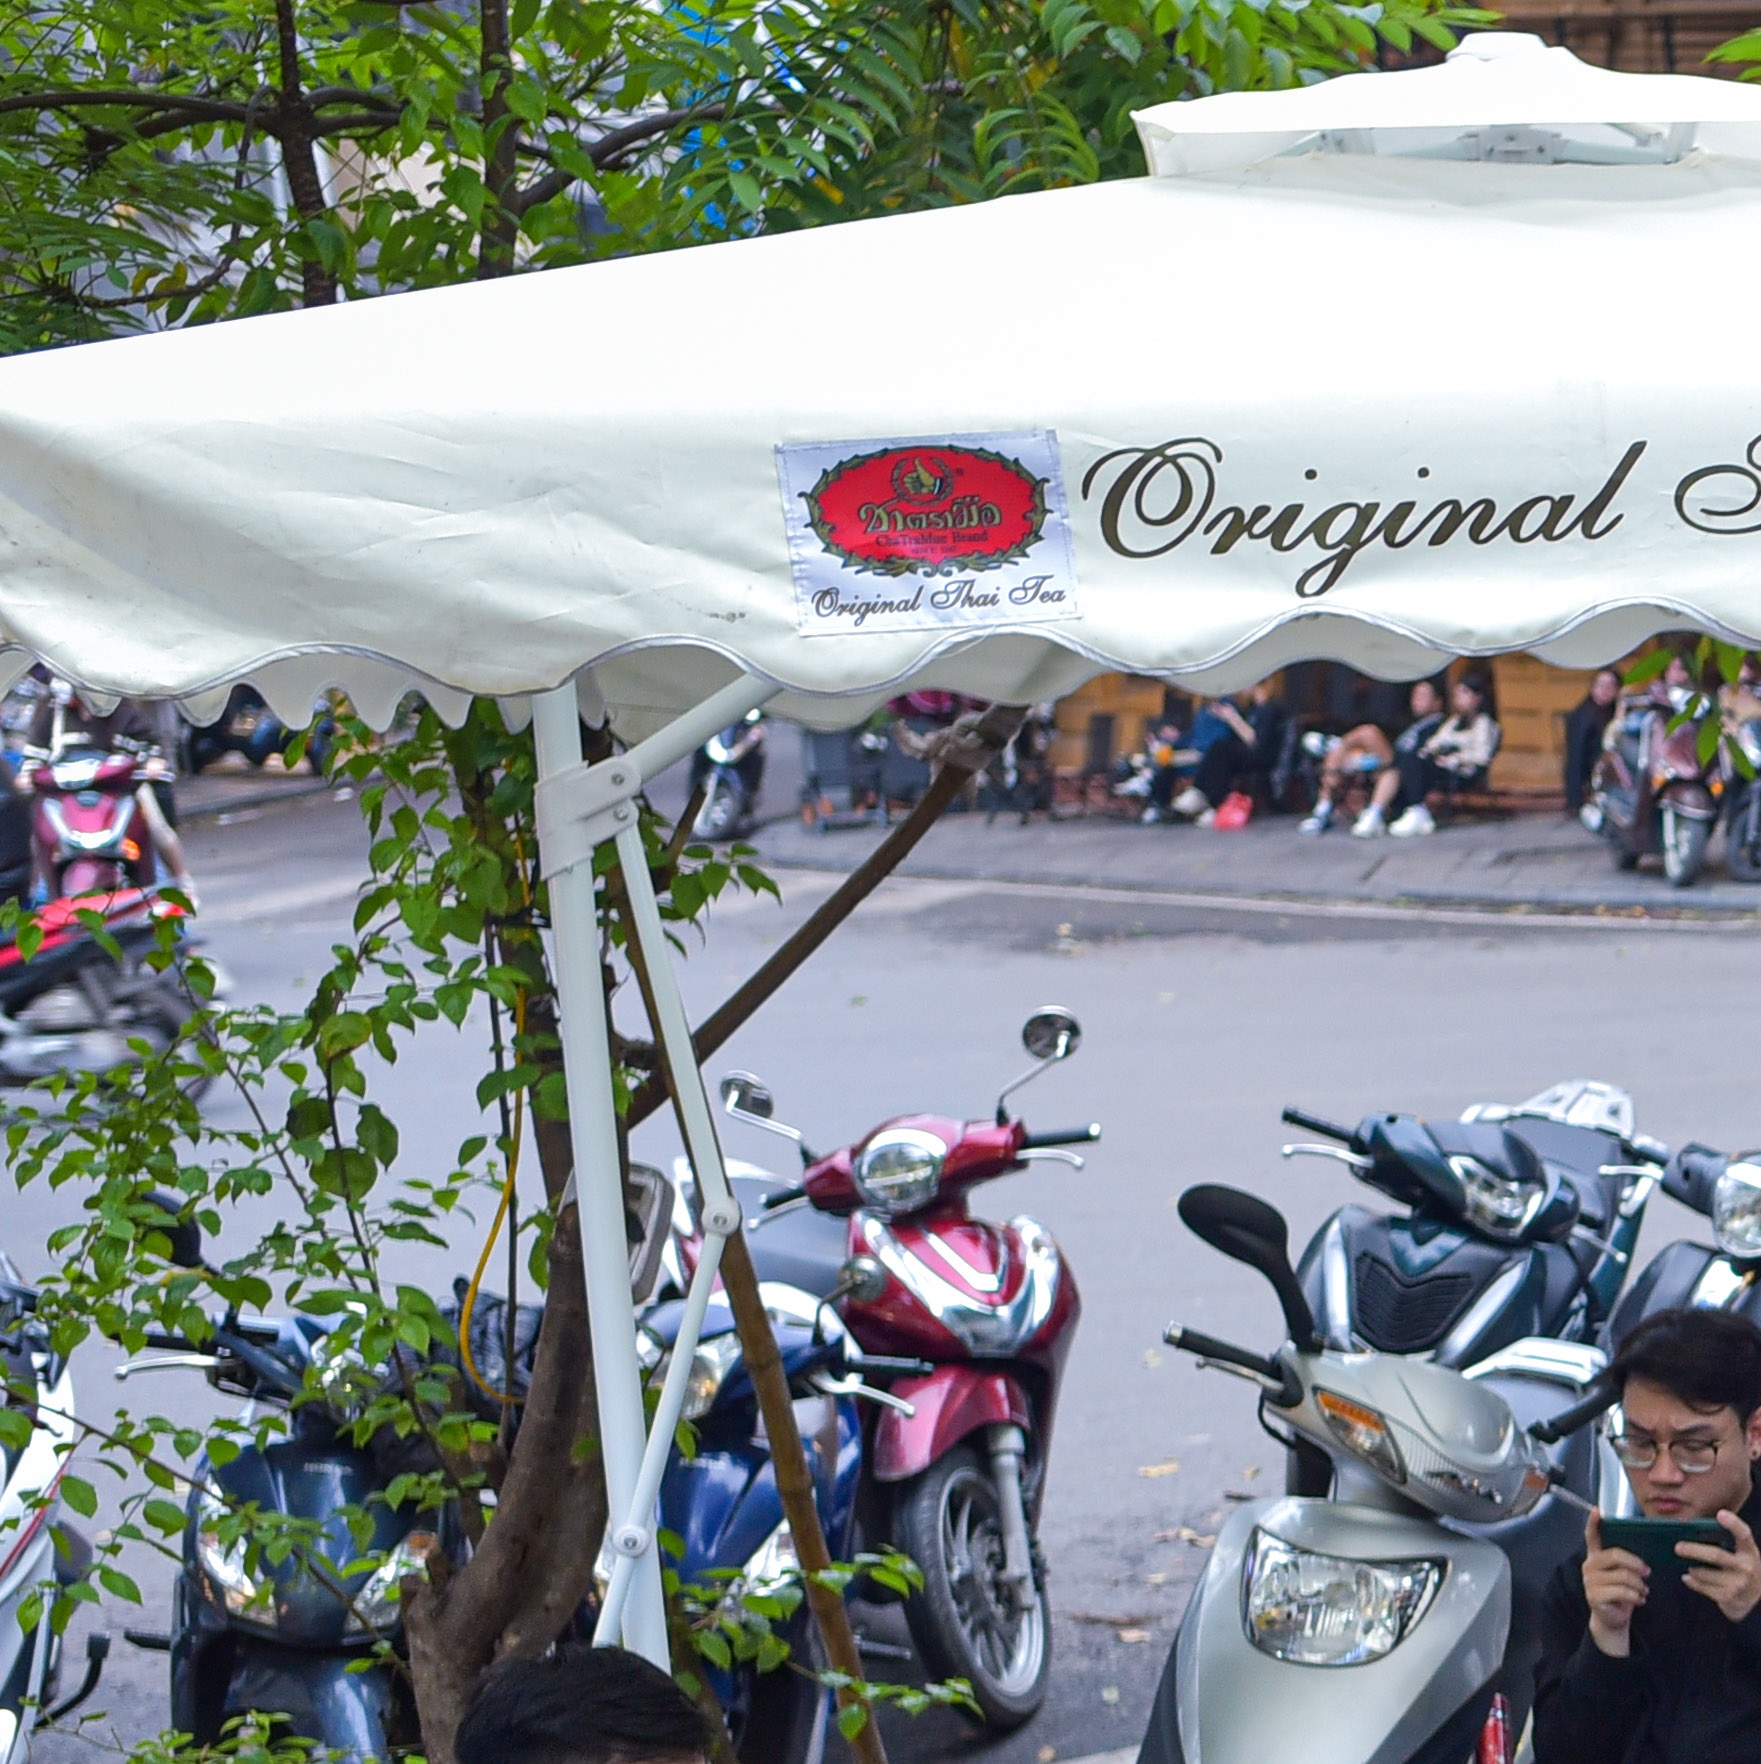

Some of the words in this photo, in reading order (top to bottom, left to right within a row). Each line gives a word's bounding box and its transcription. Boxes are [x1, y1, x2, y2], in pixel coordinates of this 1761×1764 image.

[952, 530, 989, 545] Brand
[1081, 436, 1647, 600] Original
[811, 584, 924, 627] Original
[929, 578, 1001, 612] Thai
[1008, 574, 1067, 606] Tea
